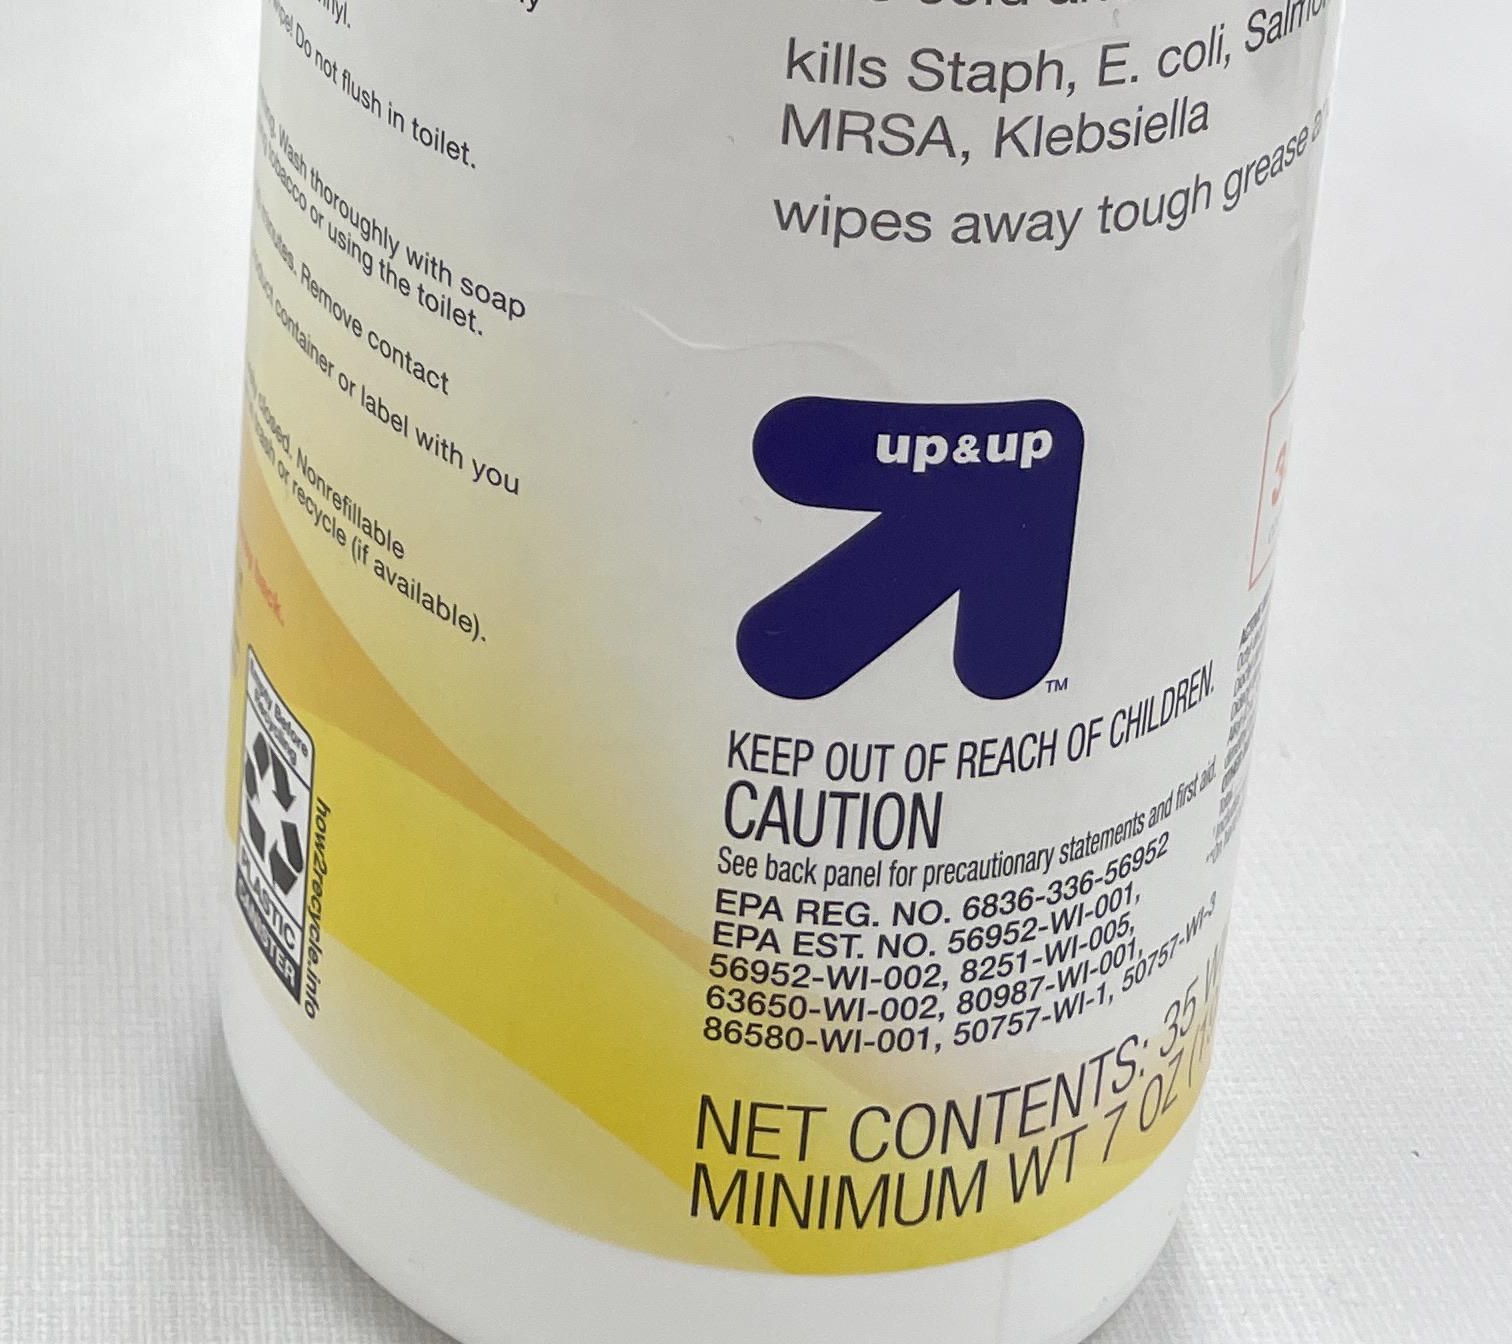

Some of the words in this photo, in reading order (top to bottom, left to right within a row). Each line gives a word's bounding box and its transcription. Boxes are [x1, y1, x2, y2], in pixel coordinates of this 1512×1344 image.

[296, 23, 312, 57] Do
[315, 49, 337, 85] not
[342, 70, 382, 118] flush
[388, 102, 404, 133] in
[412, 118, 475, 169] toilet.
[786, 37, 888, 90] kills
[907, 47, 1076, 103] Staph,
[1097, 42, 1138, 88] E.
[1157, 23, 1232, 78] coli,
[773, 194, 933, 248] wipes
[950, 206, 1083, 251] away
[1097, 174, 1213, 234] tough
[1222, 123, 1308, 212] grease
[780, 103, 970, 167] MRSA,
[994, 94, 1210, 160] Klebsiella
[310, 206, 324, 229] or
[328, 222, 373, 276] using
[379, 260, 410, 296] the
[418, 286, 483, 336] toilet.
[311, 170, 400, 259] thoroughly
[407, 244, 452, 287] with
[461, 276, 525, 319] soap
[301, 263, 363, 338] Remove
[368, 330, 449, 395] contact
[338, 371, 356, 396] or
[361, 385, 408, 438] label
[415, 427, 463, 470] with
[472, 458, 519, 495] you
[876, 428, 1053, 472] up&up
[292, 479, 346, 546] recycle
[374, 559, 486, 642] available).
[297, 447, 405, 559] Nonrefillable
[727, 730, 814, 776] KEEP
[826, 742, 898, 783] OUT
[904, 742, 949, 782] OF
[956, 732, 1058, 781] REACH
[1065, 718, 1104, 760] OF
[1110, 660, 1215, 745] CHILDREN.
[717, 847, 757, 879] See
[766, 851, 817, 886] back
[823, 855, 882, 892] panel
[889, 859, 915, 889] for
[922, 843, 1054, 893] precautionary
[1060, 811, 1145, 865] statements
[1145, 789, 1173, 822] and
[1176, 772, 1198, 810] first
[724, 780, 943, 850] CAUTION
[303, 796, 332, 1020] how2recycle.info
[712, 922, 781, 955] EPA
[793, 932, 865, 959] EST.
[878, 932, 937, 959] NO.
[949, 880, 1141, 954] 56952-WI-001,
[715, 888, 783, 923] EPA
[796, 899, 881, 927] REG.
[893, 900, 951, 927] NO.
[963, 832, 1169, 922] 6836-336-56952
[705, 985, 945, 1023] 63650-WI-002,
[957, 936, 1142, 1015] 80987-WI-001,
[708, 955, 949, 991] 56952-WI-002,
[961, 912, 1136, 985] 8251-WI-005,
[696, 1094, 827, 1163] NET
[849, 1035, 1148, 1164] CONTENTS:
[1160, 977, 1199, 1056] 35
[702, 1017, 941, 1053] 86580-WI-001,
[953, 987, 1114, 1047] 50757-WI-1,
[690, 1159, 987, 1231] MINIMUM
[1009, 1124, 1088, 1204] WT
[1102, 1105, 1128, 1164] 7
[1138, 1049, 1185, 1134] OZ
